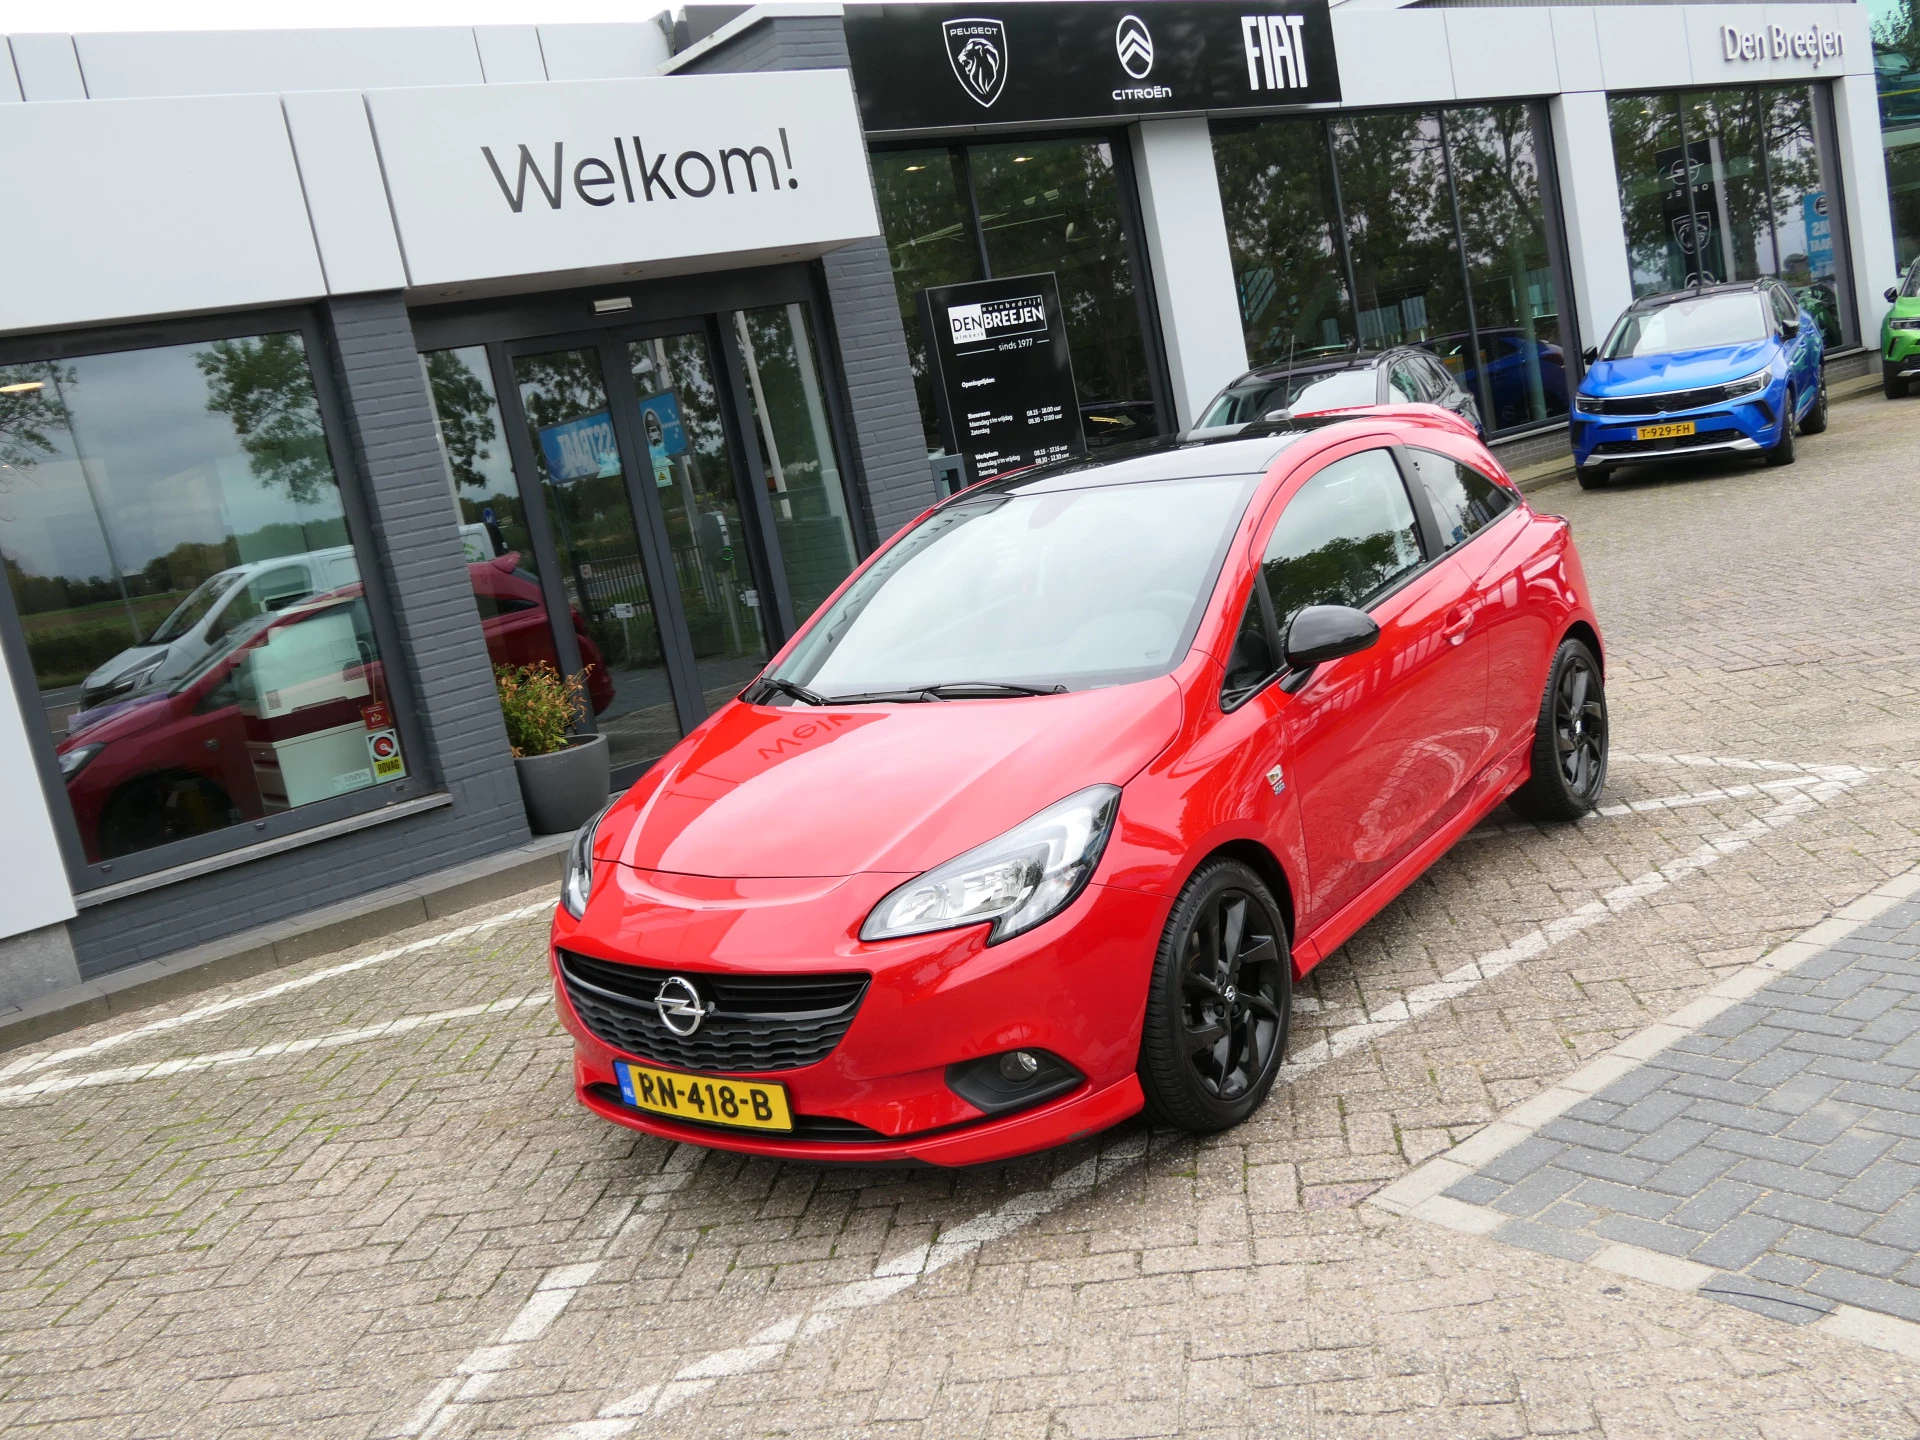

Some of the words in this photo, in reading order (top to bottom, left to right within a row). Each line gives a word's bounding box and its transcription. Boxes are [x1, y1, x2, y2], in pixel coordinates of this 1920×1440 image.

[950, 26, 998, 37] PEUGEOT
[1240, 15, 1309, 90] FIAT
[1720, 24, 1766, 62] Den
[1767, 21, 1845, 69] Breejen
[480, 127, 798, 213] Welkom!
[981, 298, 1042, 312] autobedrijf
[951, 315, 984, 333] DEN
[982, 305, 1044, 329] BREEJEN
[999, 341, 1017, 352] sinds
[1018, 338, 1034, 348] 1977
[1640, 424, 1690, 438] T-929-FH
[376, 759, 401, 775] BOVAG
[623, 1086, 635, 1098] NL
[638, 1072, 773, 1121] RN-418-B
